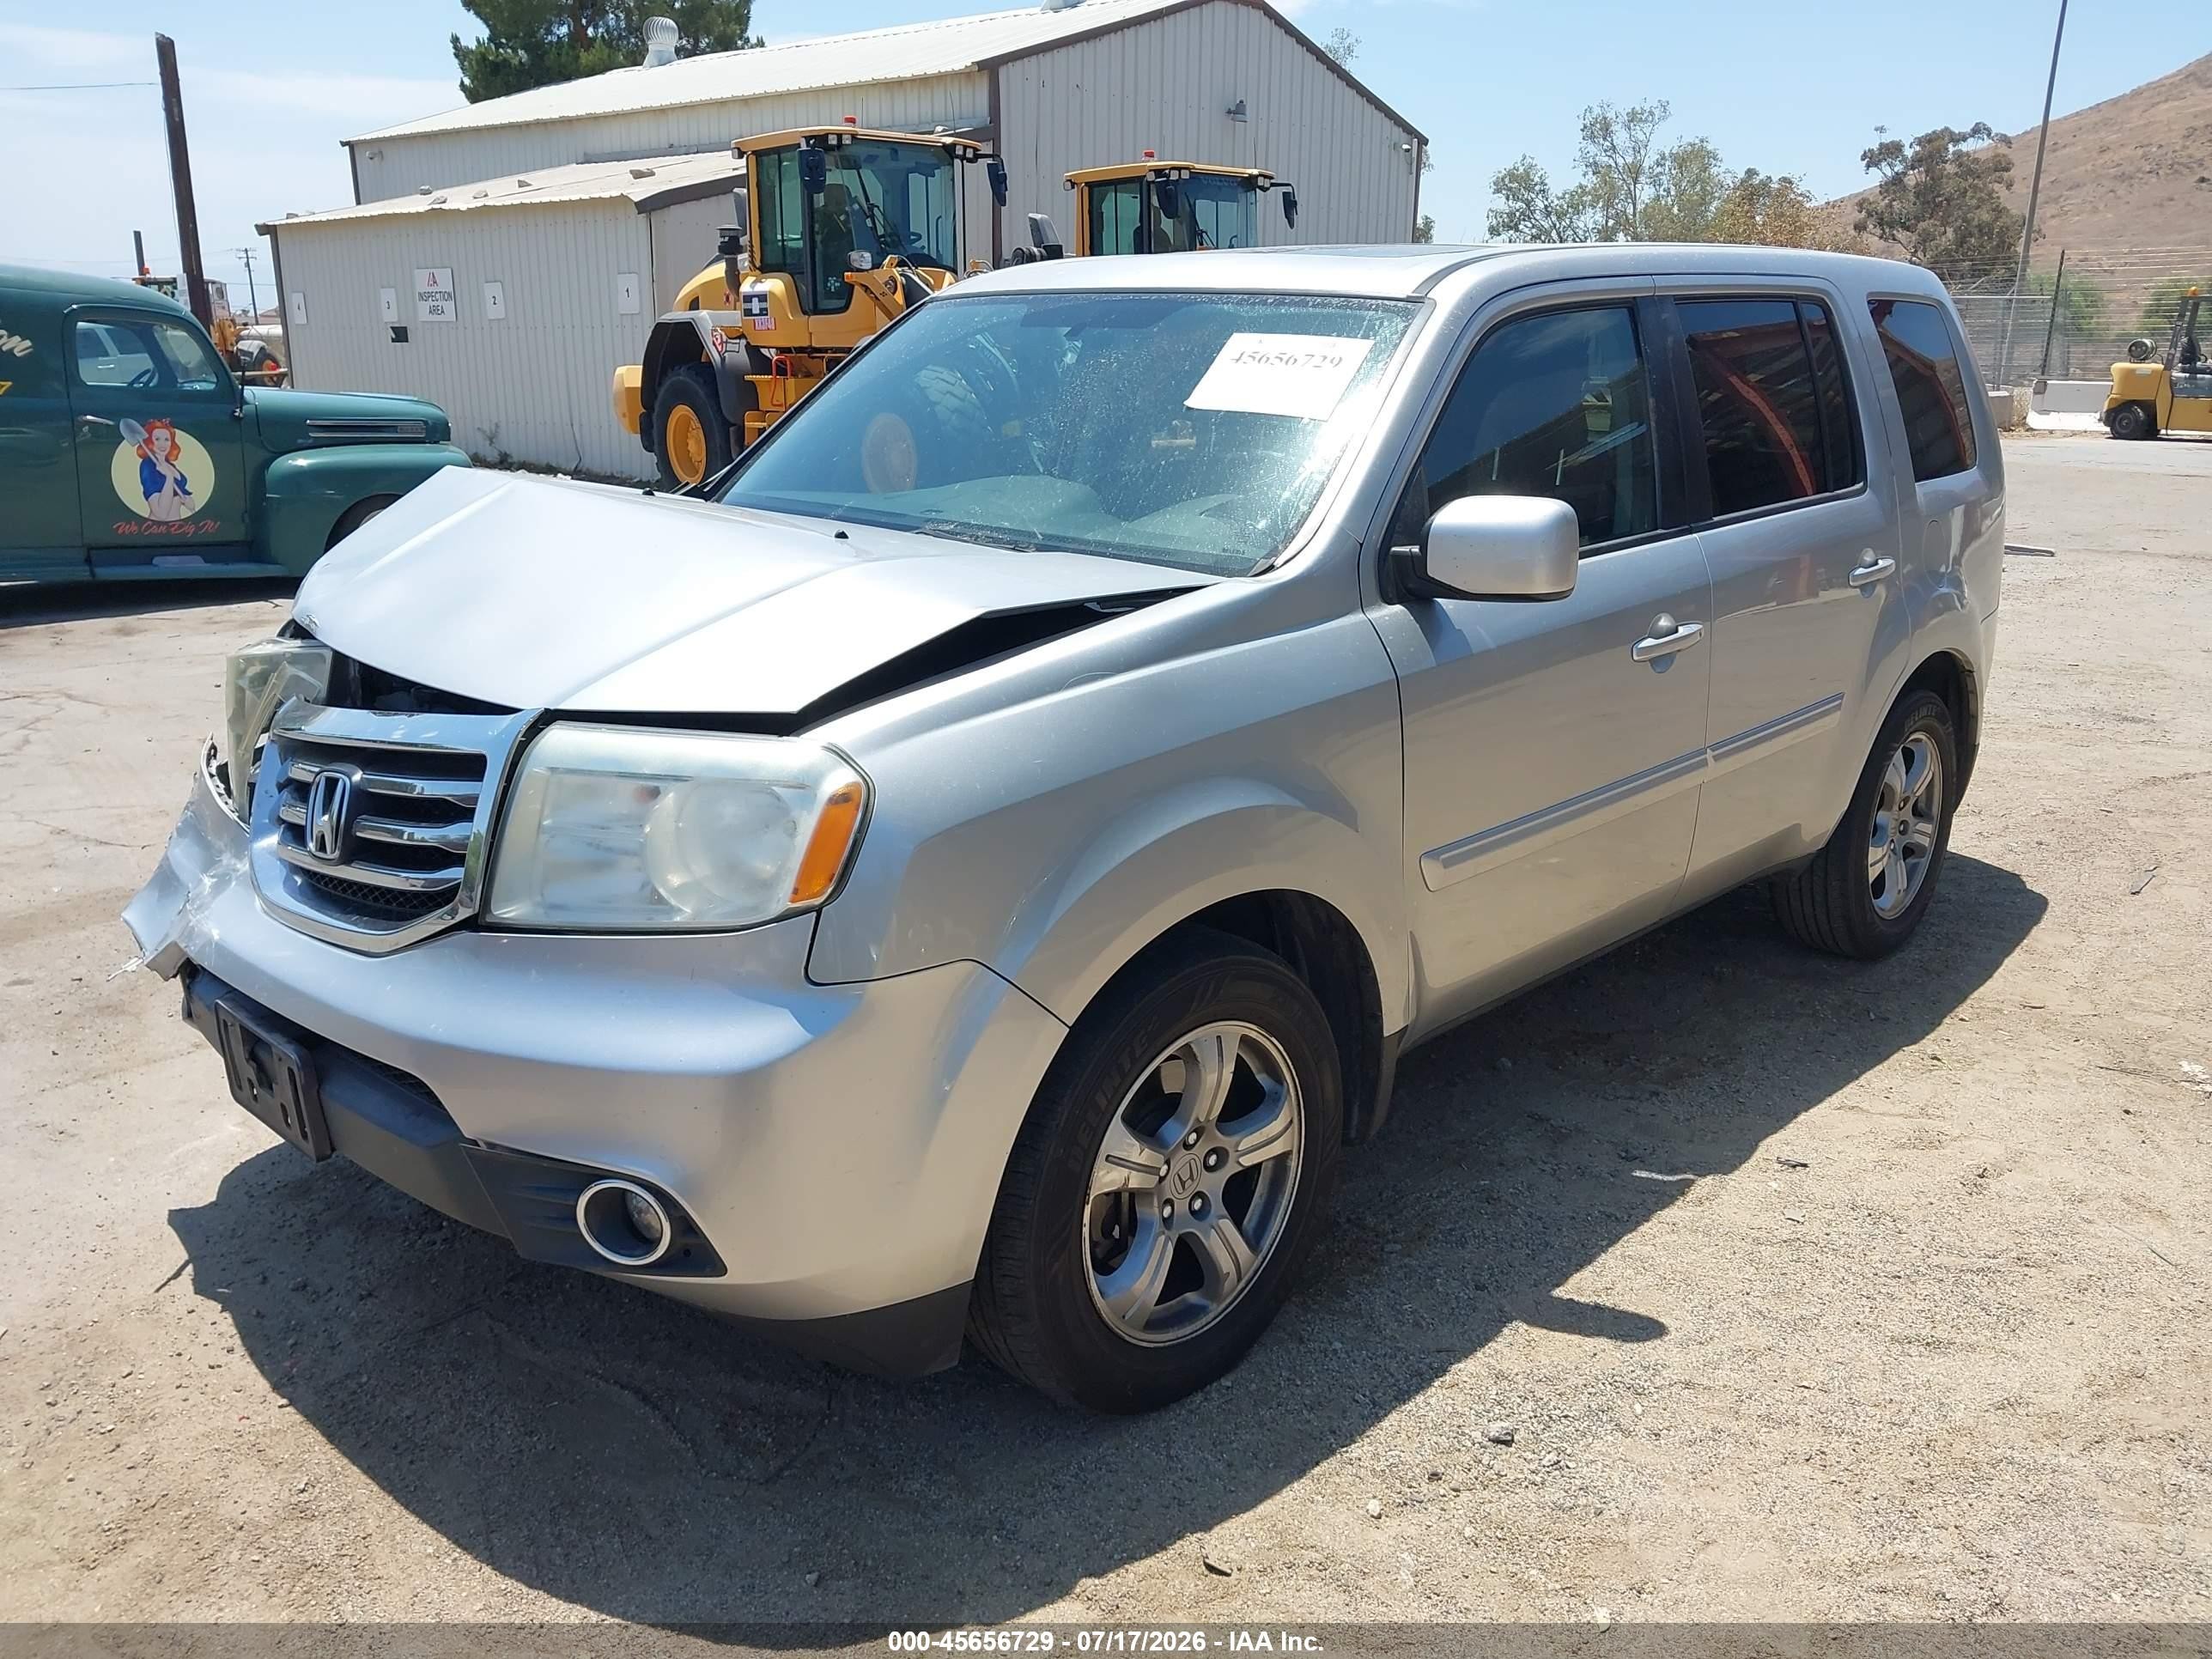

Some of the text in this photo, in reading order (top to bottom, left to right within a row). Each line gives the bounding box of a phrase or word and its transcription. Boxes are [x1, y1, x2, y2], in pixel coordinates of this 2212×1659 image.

[417, 290, 453, 302] INSPECTION
[492, 295, 498, 306] 2
[386, 301, 391, 310] 3
[428, 304, 446, 316] AREA
[1230, 350, 1343, 369] 45656729
[112, 520, 137, 535] We
[140, 520, 167, 536] Can
[167, 520, 196, 538] Dig
